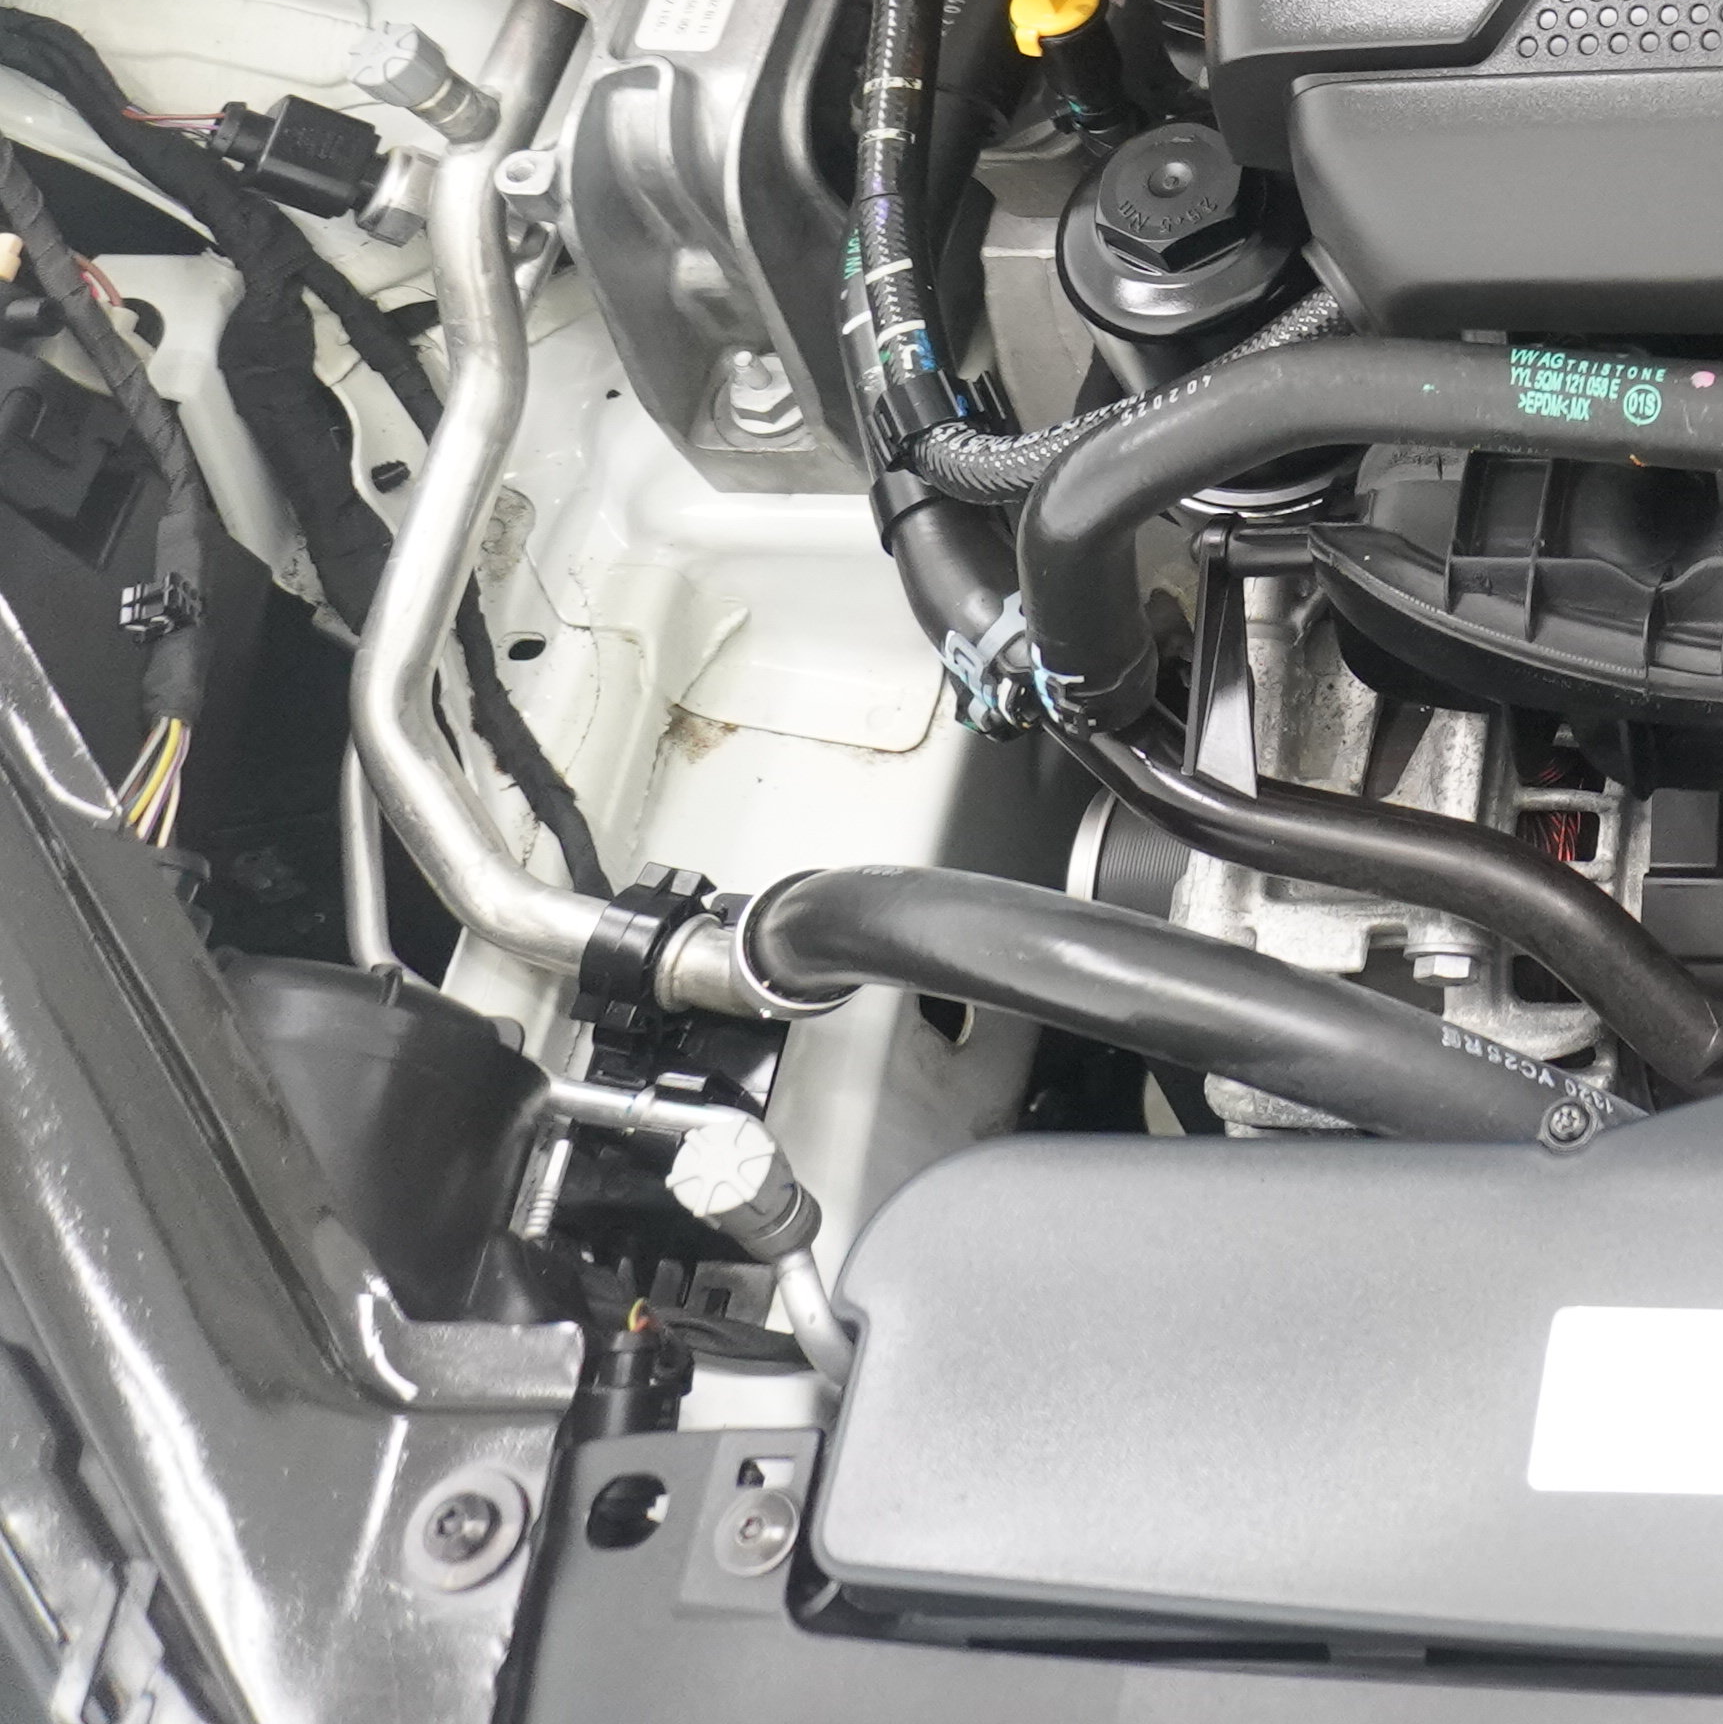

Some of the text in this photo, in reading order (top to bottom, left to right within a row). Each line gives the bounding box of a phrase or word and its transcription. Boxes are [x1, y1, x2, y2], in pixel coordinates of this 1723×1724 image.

[1510, 348, 1668, 383] VW AG TRISTONE
[1510, 367, 1532, 388] YYL
[1565, 375, 1586, 394] 121
[1628, 393, 1657, 417] 01S
